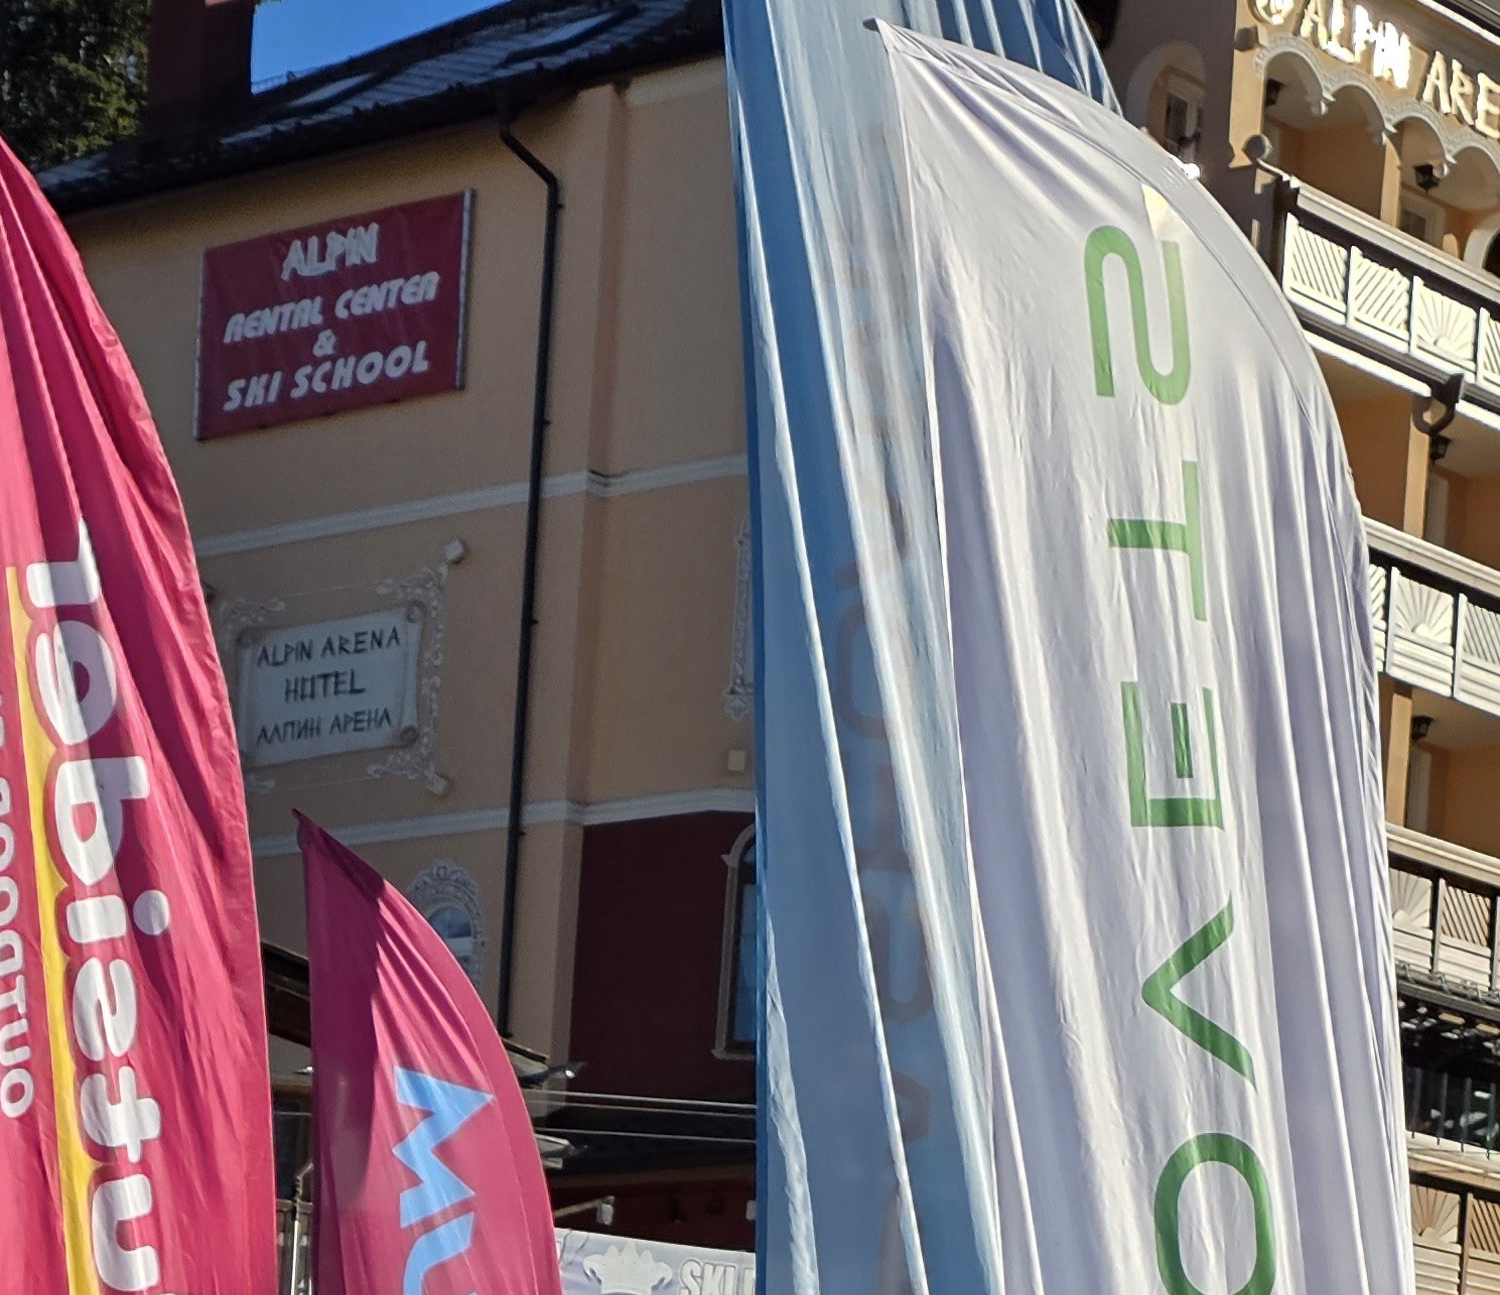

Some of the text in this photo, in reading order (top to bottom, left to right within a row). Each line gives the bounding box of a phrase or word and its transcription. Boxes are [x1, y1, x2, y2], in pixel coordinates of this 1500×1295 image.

[1300, 0, 1411, 89] ALPIN
[281, 222, 379, 282] ALPIN
[223, 270, 441, 344] RENTAL CENTER
[312, 328, 336, 358] &
[222, 340, 430, 412] SKI SCHOOL
[256, 625, 400, 668] ALPIN ARENA
[284, 668, 366, 704] HOTEL
[329, 706, 392, 736] АРЕНА
